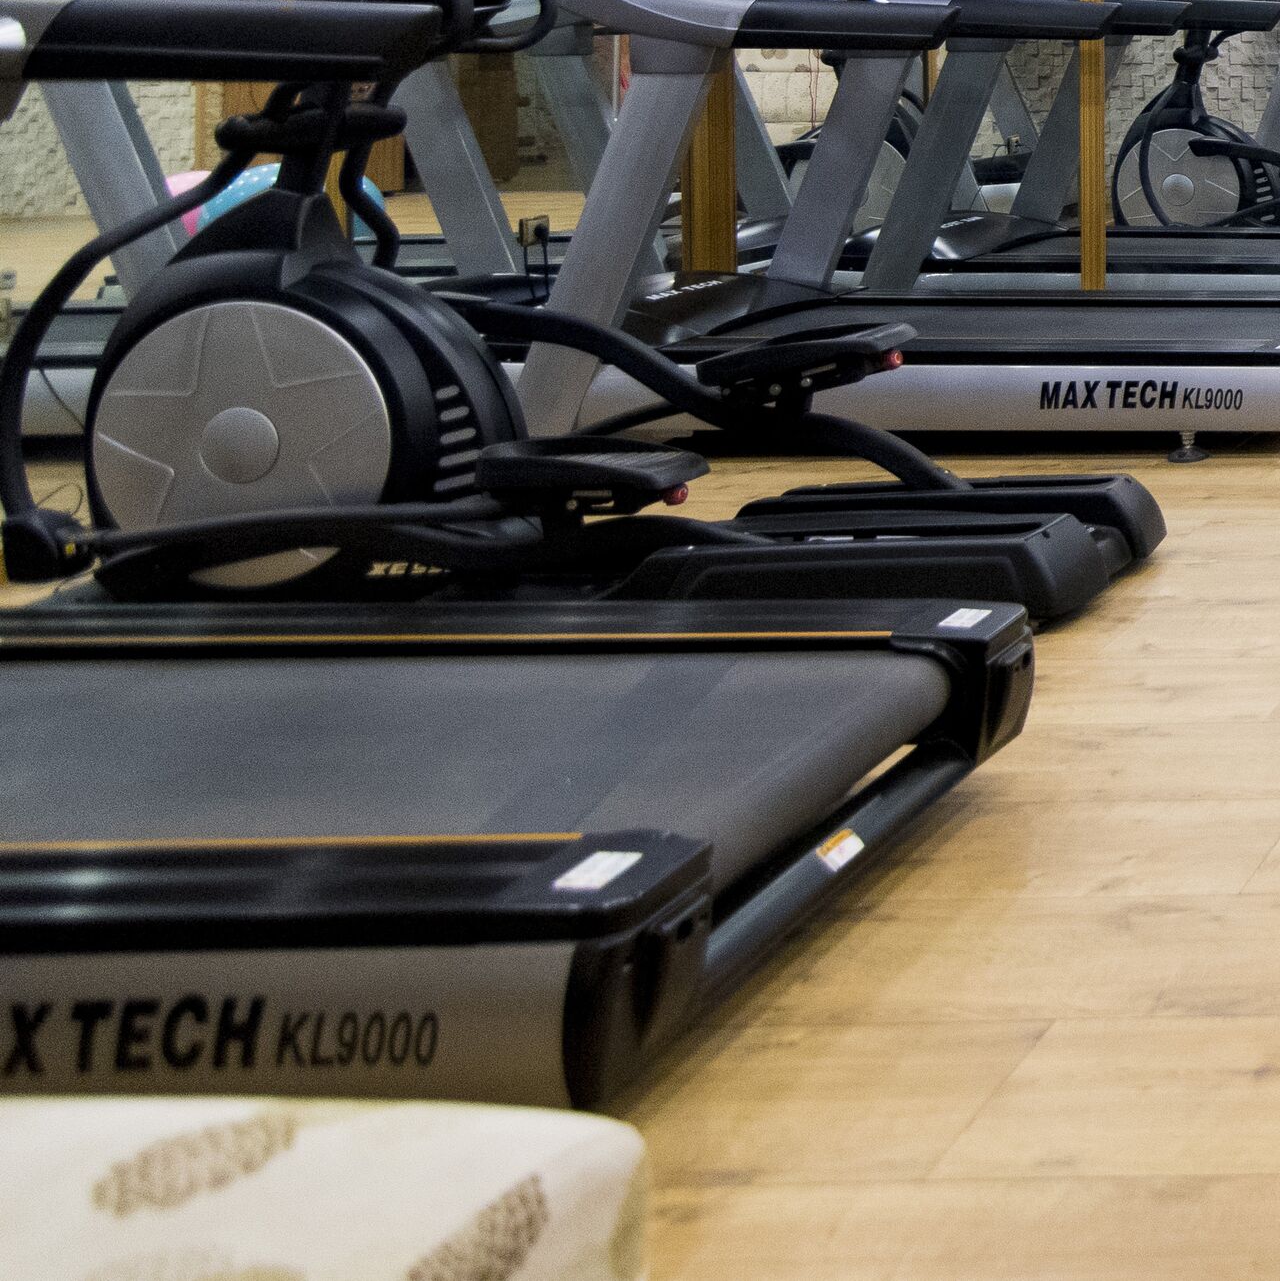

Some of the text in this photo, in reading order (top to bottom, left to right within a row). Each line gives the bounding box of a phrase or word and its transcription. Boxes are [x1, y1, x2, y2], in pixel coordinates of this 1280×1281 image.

[1039, 379, 1244, 410] MAX TECH KL9000
[71, 993, 266, 1074] TECH
[275, 1011, 440, 1068] KL9000
